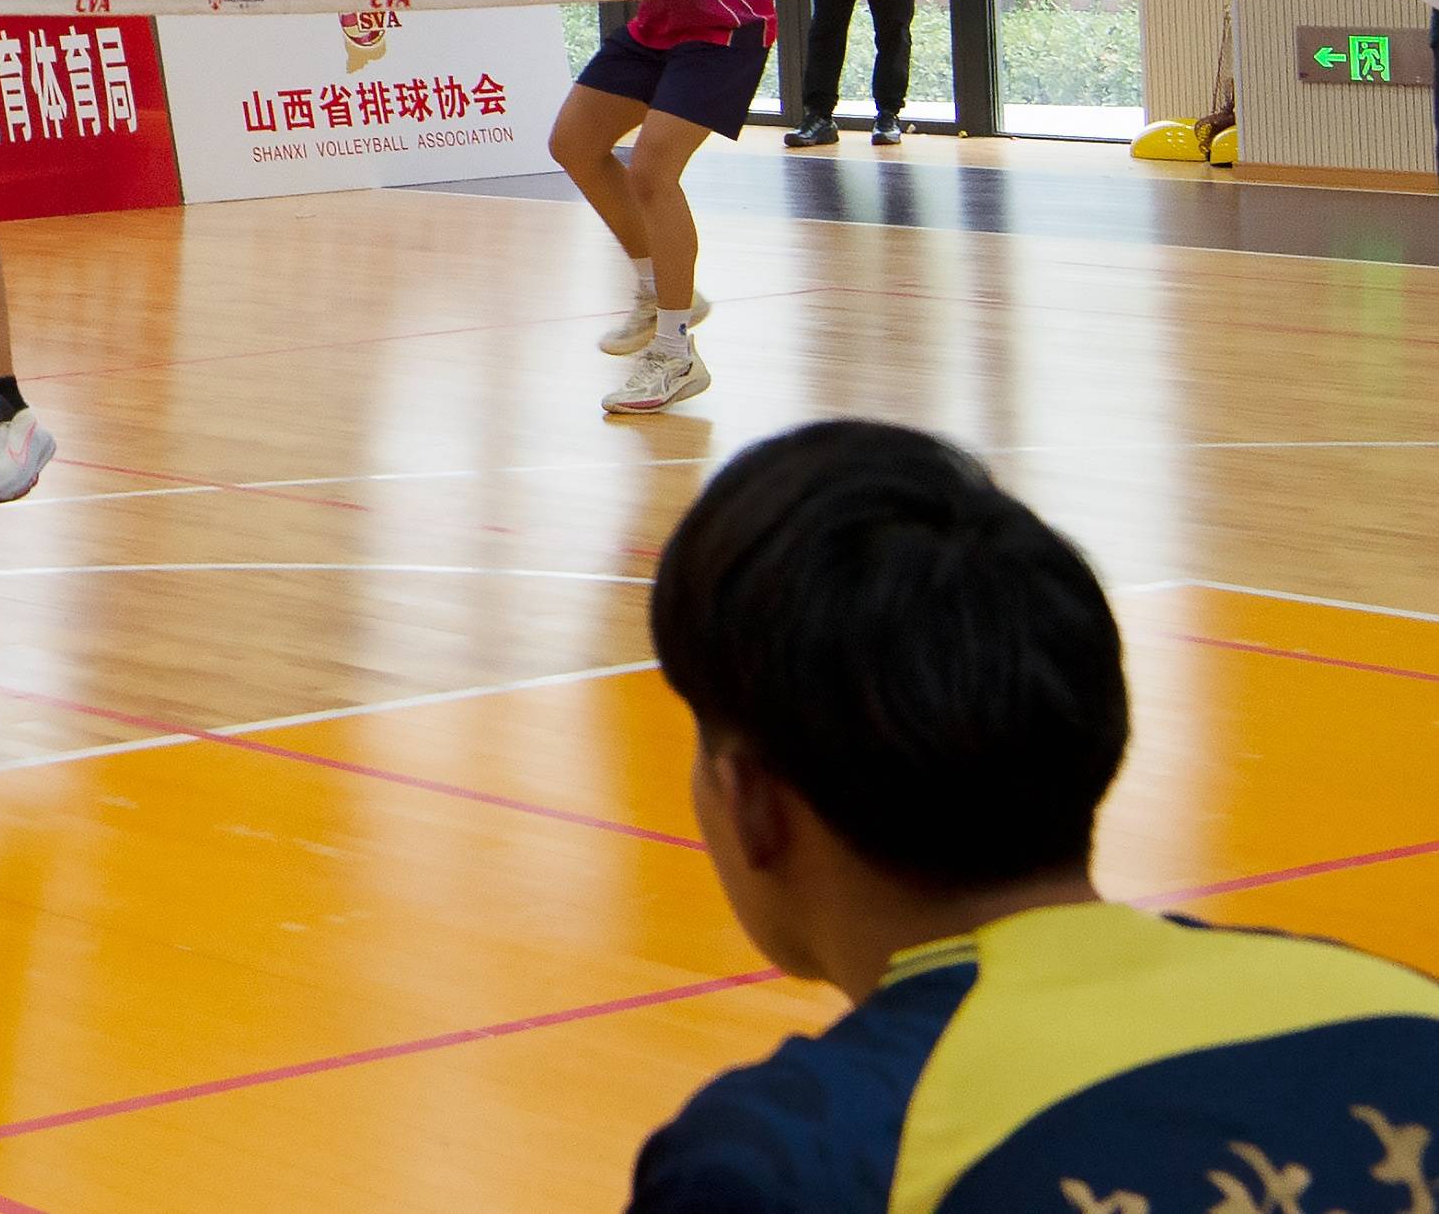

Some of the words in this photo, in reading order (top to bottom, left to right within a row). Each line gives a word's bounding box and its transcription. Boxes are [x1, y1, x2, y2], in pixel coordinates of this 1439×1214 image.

[359, 10, 402, 29] SVA
[242, 72, 508, 133] 山西省排球协会
[252, 142, 308, 164] SHANXI
[315, 135, 409, 158] VOLLEYBALL
[417, 126, 515, 149] ASSOCIATION
